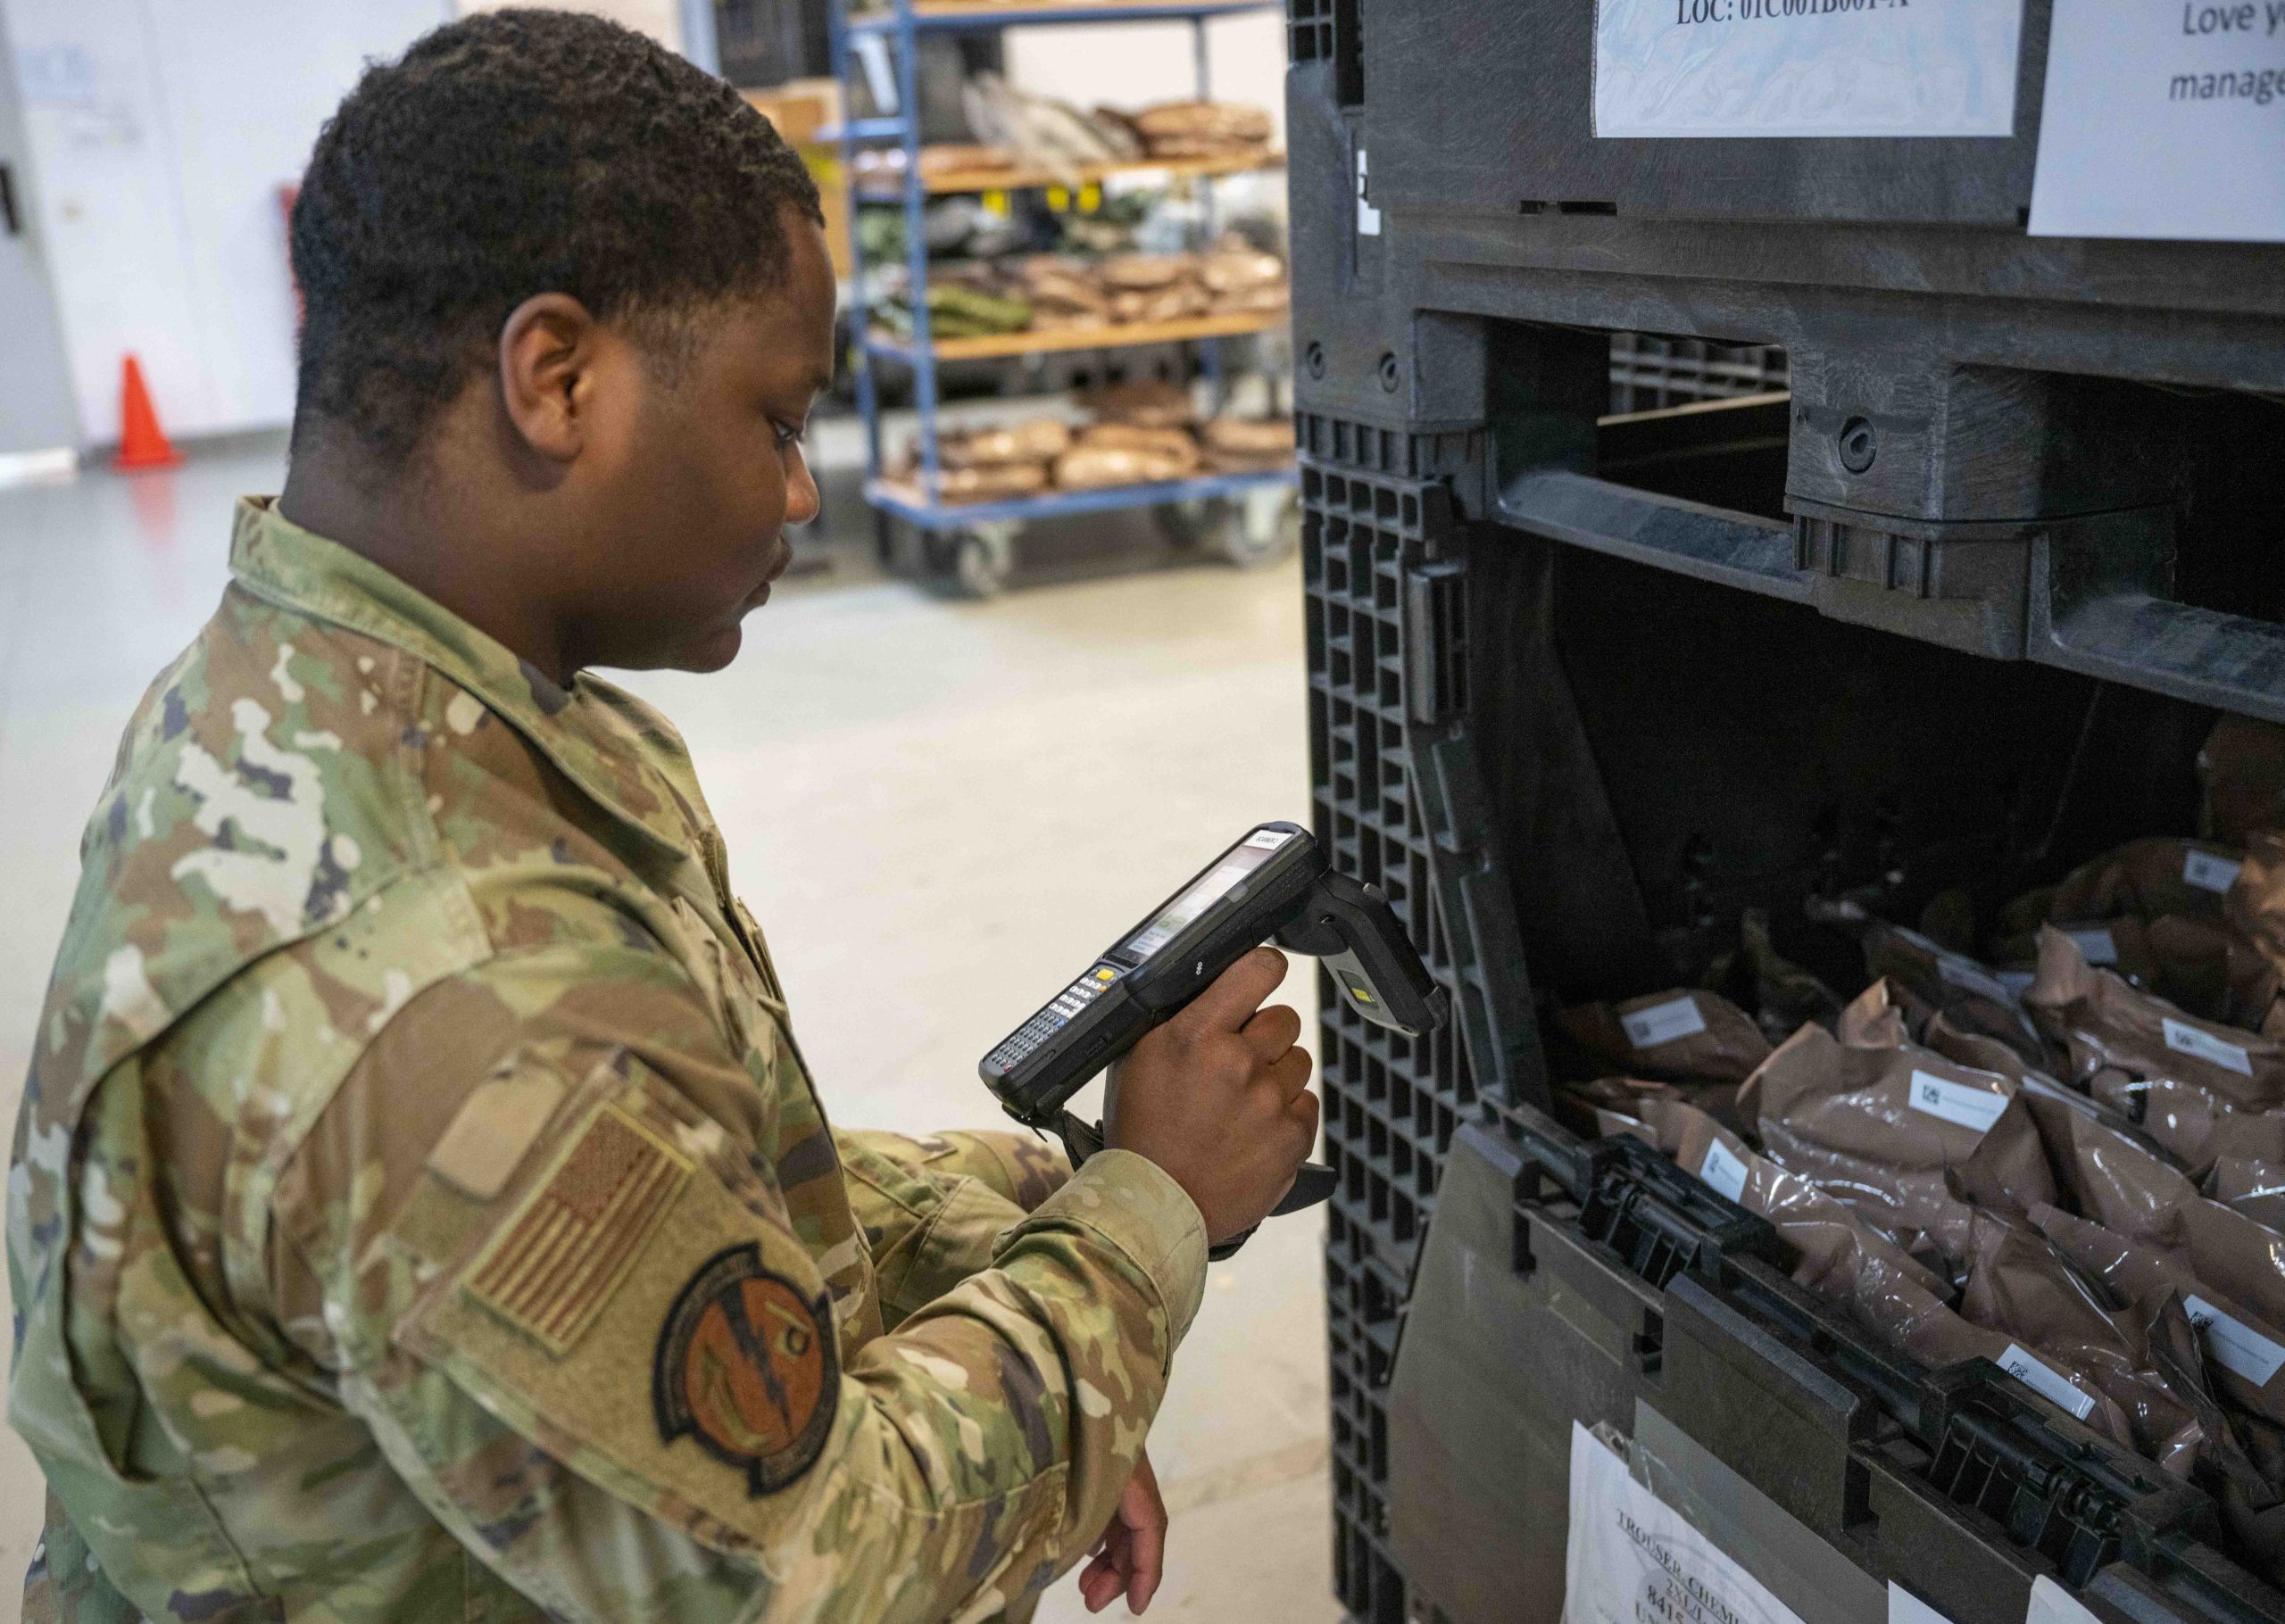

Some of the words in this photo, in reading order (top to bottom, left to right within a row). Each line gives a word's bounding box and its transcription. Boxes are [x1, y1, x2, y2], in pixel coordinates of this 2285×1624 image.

[1676, 0, 1732, 25] LOC:
[1741, 0, 1909, 20] 01C001B
[2182, 2, 2256, 35] Love
[2169, 70, 2285, 105] manage
